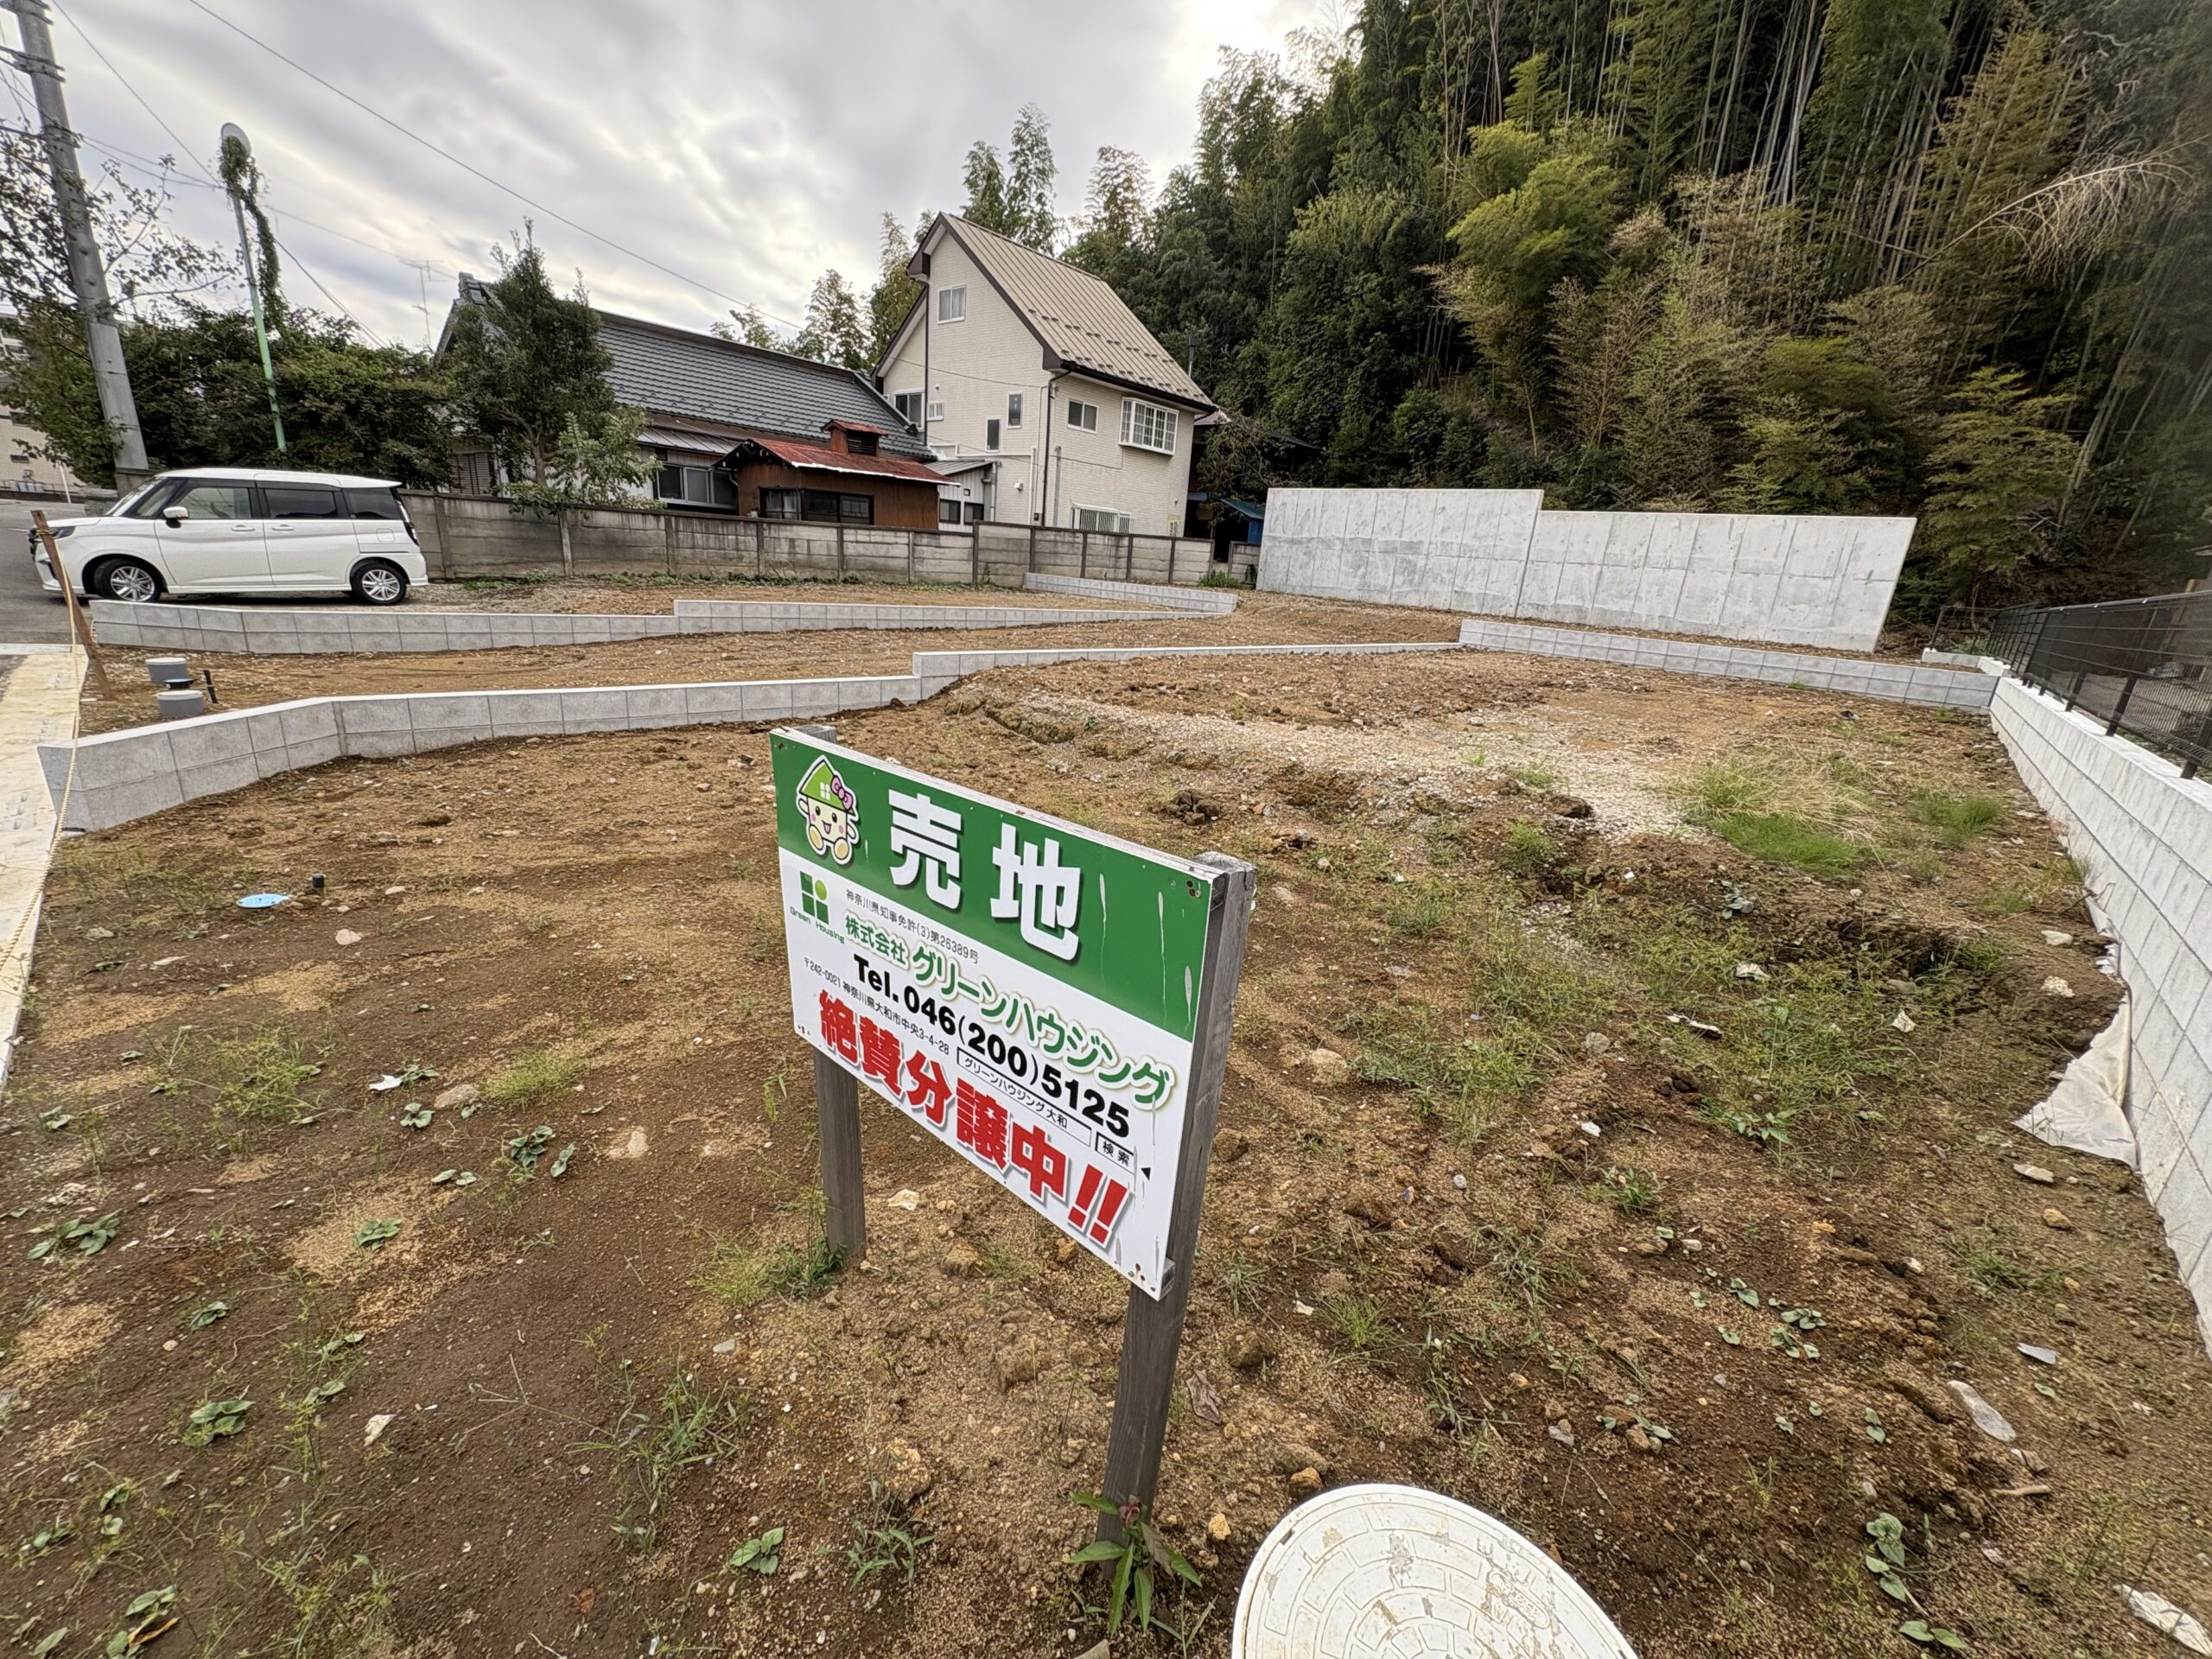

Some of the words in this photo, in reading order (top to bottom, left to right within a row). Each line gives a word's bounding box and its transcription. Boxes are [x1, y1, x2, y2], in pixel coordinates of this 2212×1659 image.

[888, 789, 1081, 961] 売地
[790, 906, 810, 925] Green
[816, 921, 845, 944] Housing
[1102, 1140, 1130, 1167] 検索
